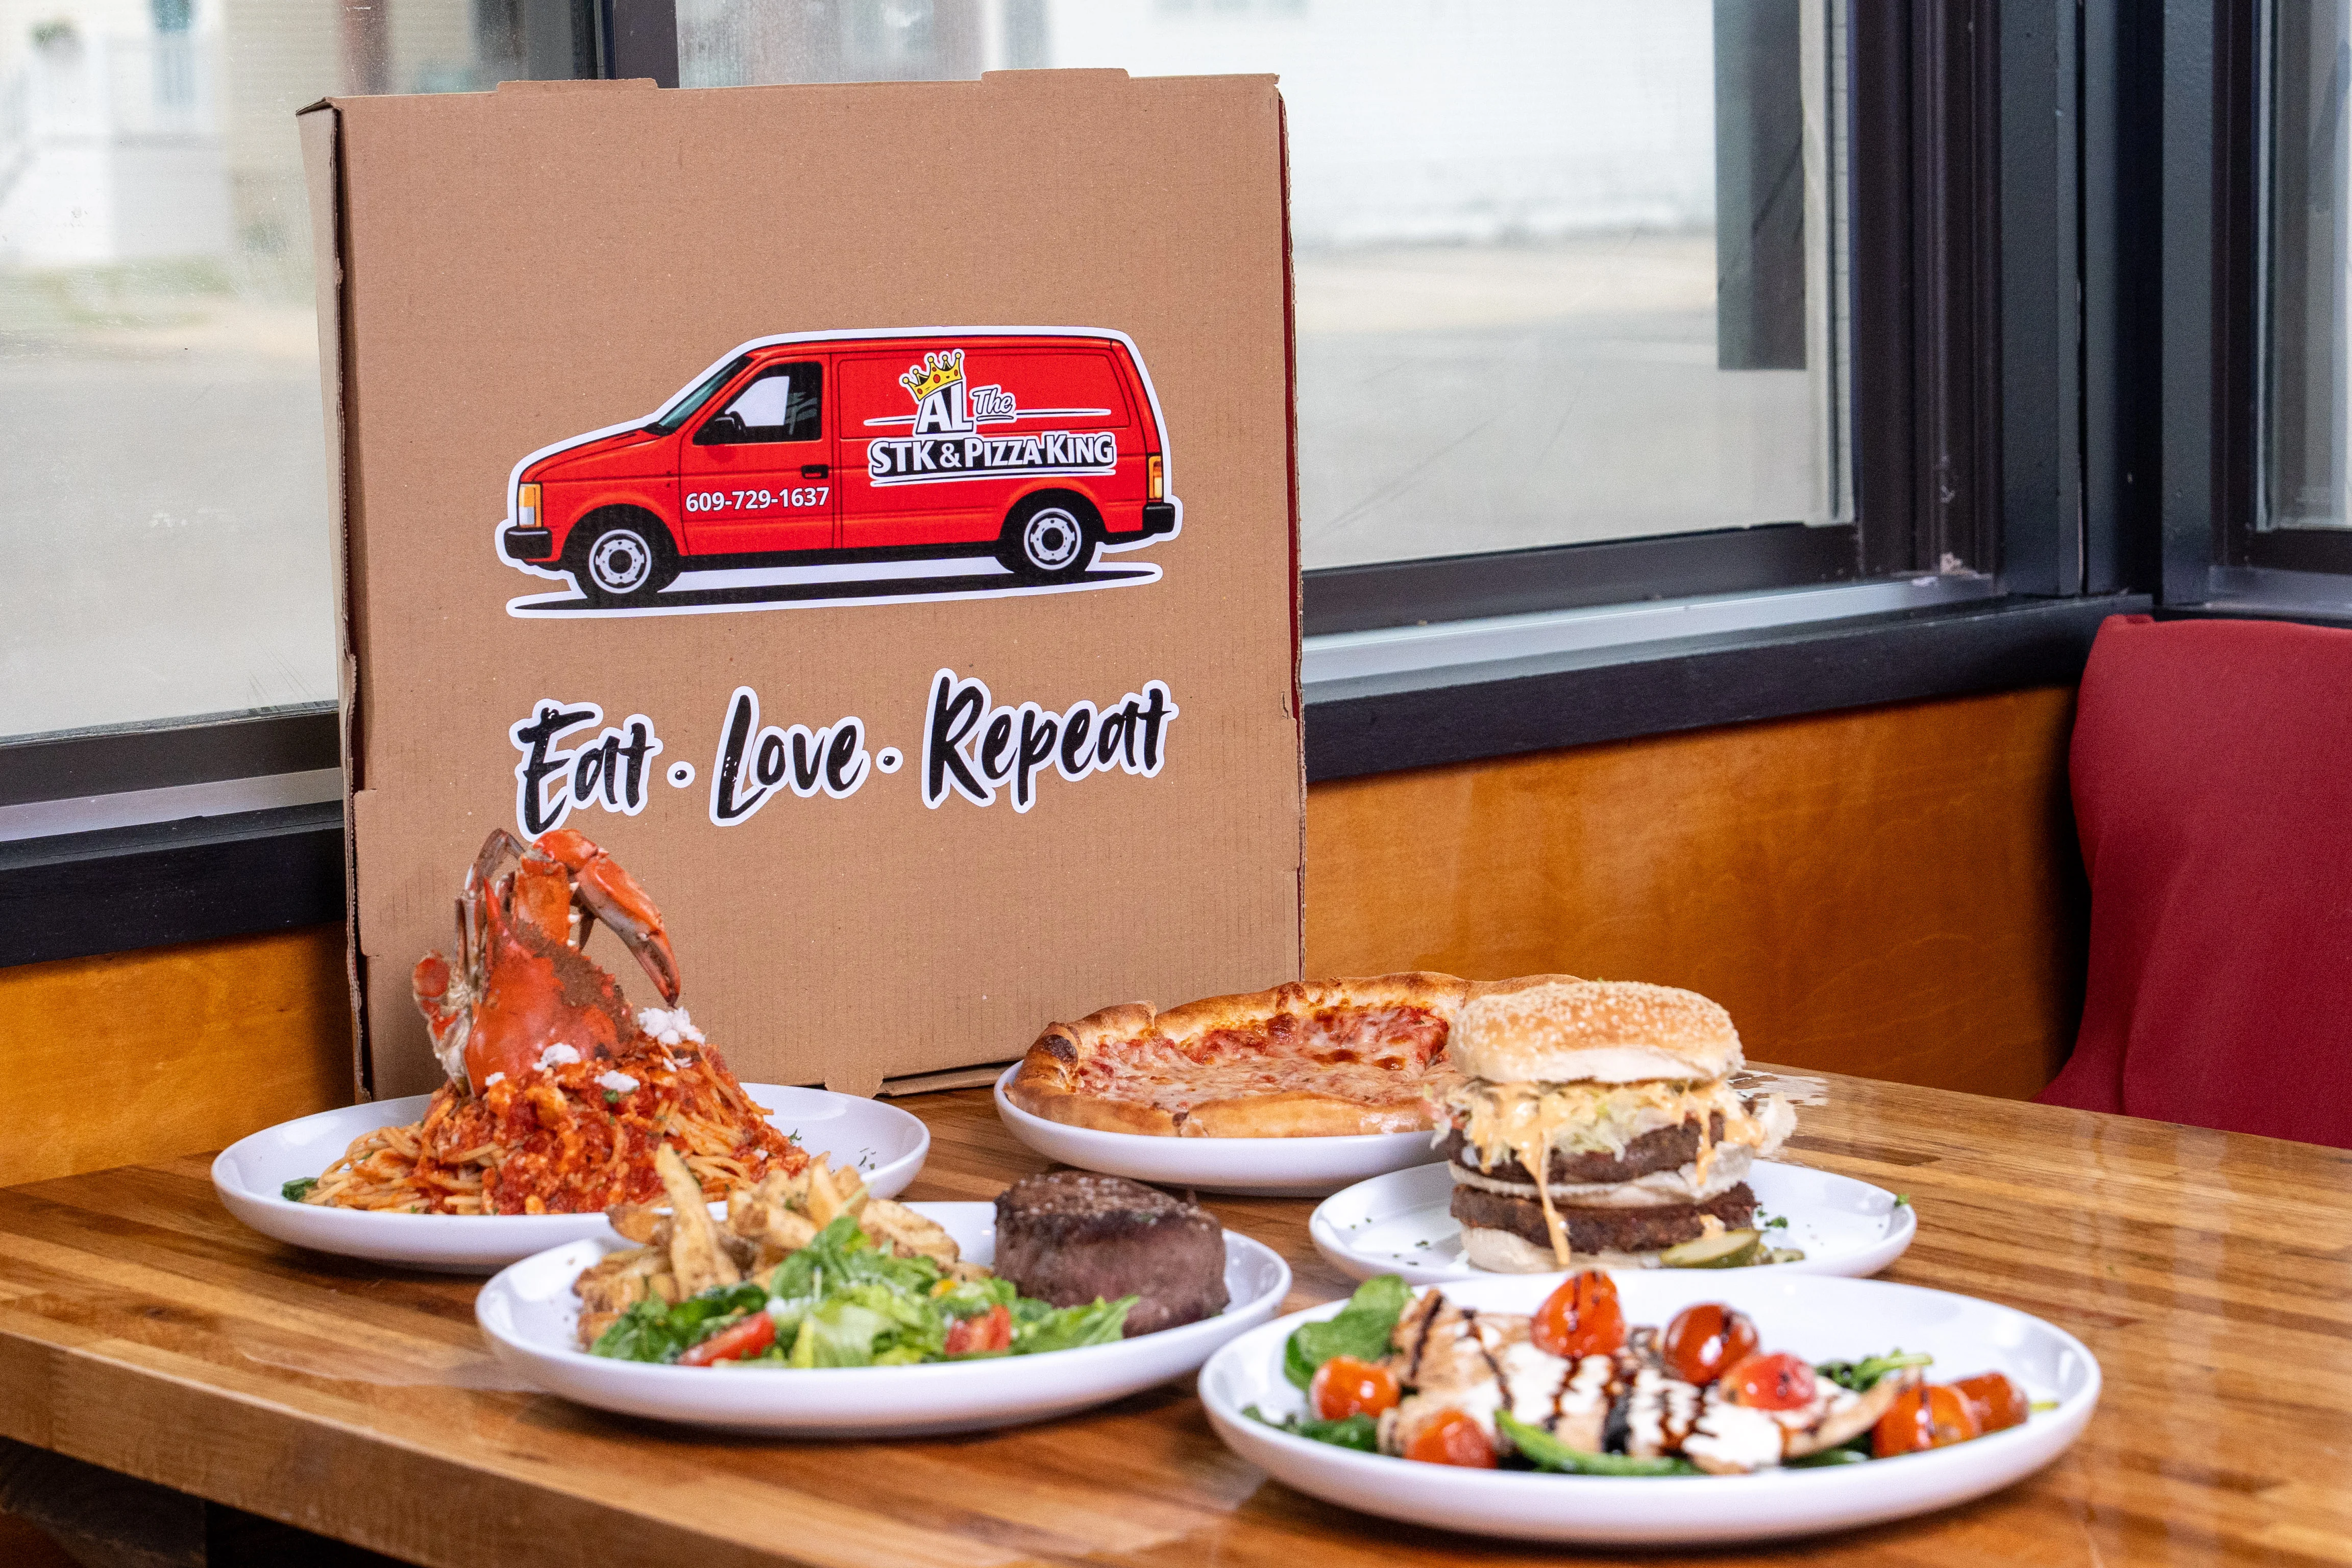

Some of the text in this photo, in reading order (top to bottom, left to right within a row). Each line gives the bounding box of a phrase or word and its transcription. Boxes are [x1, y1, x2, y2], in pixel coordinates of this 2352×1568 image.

[917, 381, 1013, 434] AL The
[871, 434, 1114, 474] STK & PIZZA KING
[686, 487, 829, 512] 609-729-1637
[517, 676, 1171, 835] Eat Love Repeat
